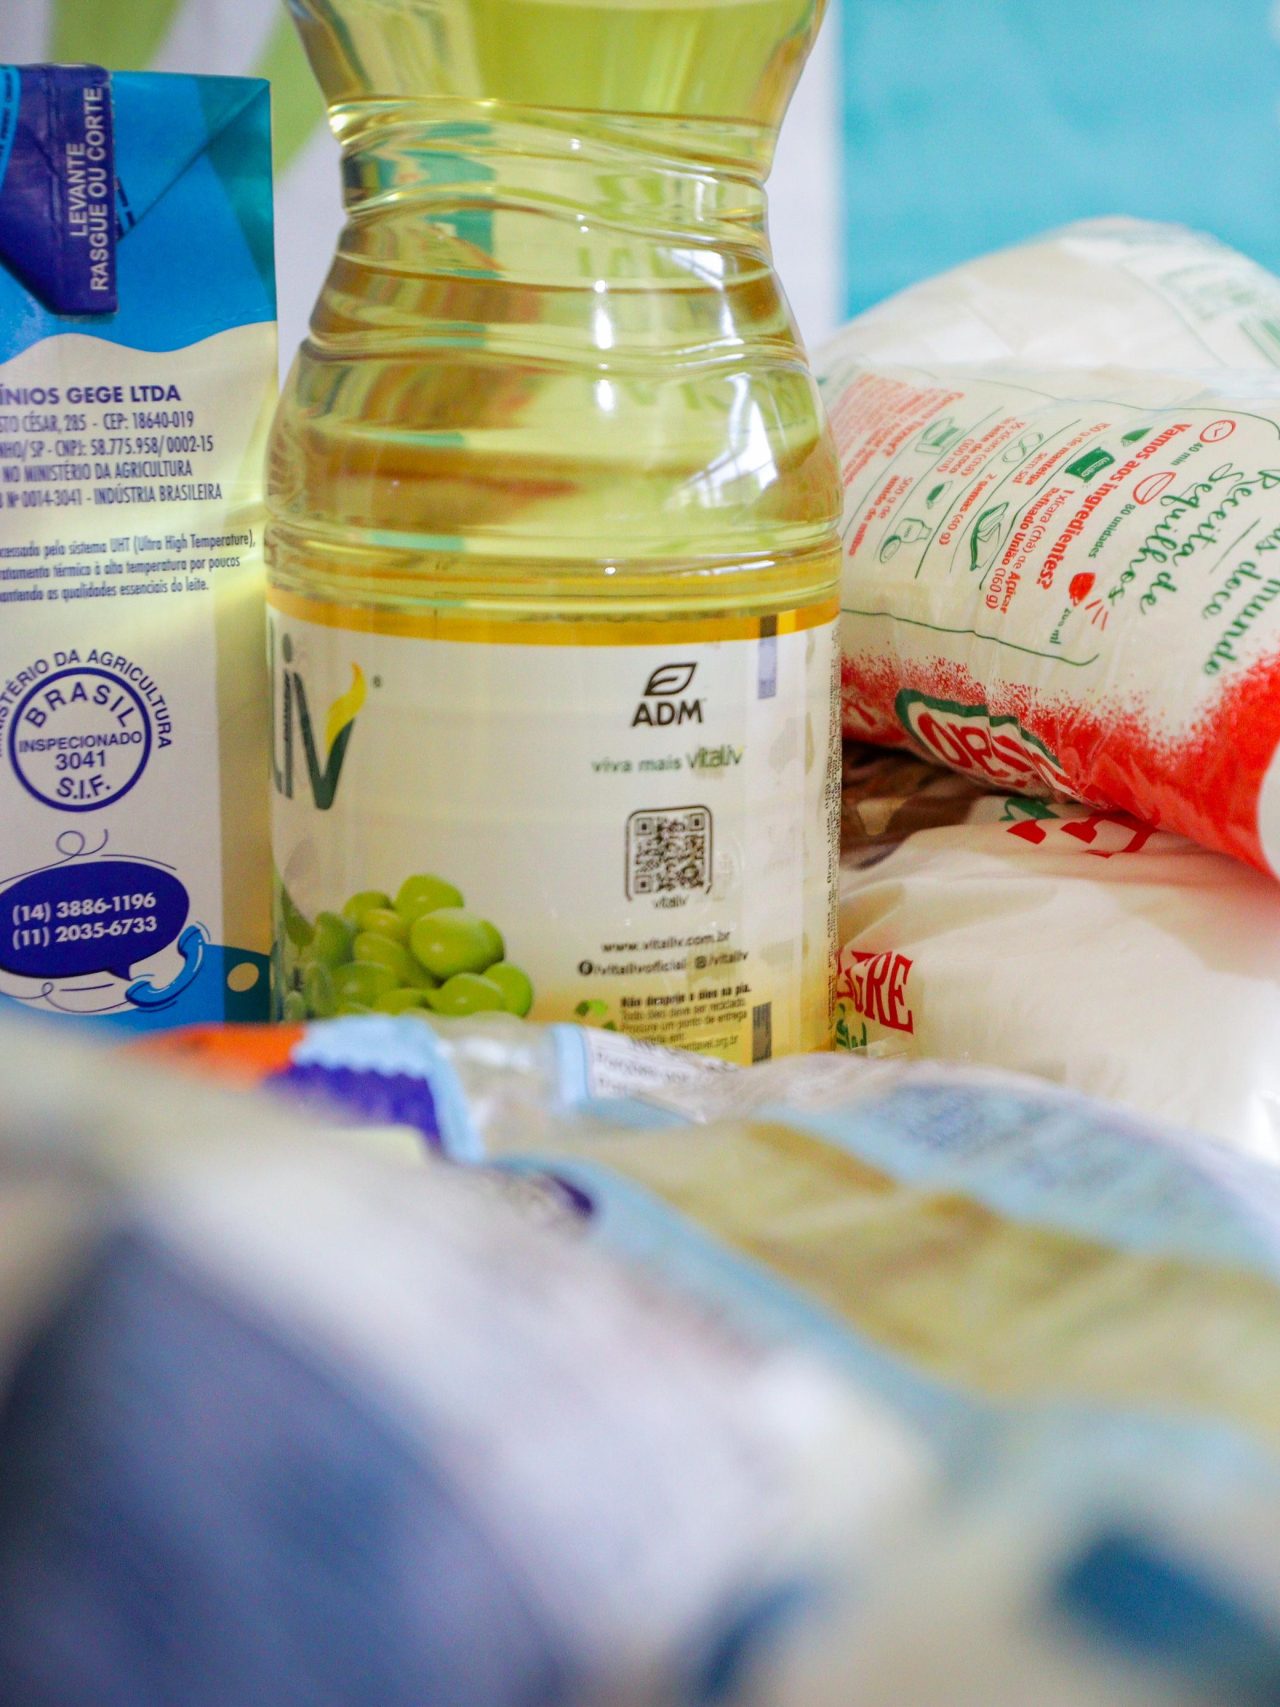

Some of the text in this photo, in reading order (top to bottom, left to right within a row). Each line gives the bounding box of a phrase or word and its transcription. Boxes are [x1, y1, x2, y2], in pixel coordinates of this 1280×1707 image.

[66, 142, 88, 236] LEVANTE
[83, 87, 109, 291] RASGUE OU CORTE
[66, 386, 123, 404] GEGE
[130, 384, 182, 402] LTDA
[23, 410, 62, 434] CÉSAR,
[103, 412, 128, 430] CEP:
[132, 410, 194, 429] 18640-019
[30, 440, 44, 458] SP
[1170, 453, 1190, 466] min
[24, 459, 91, 482] MINISTÉRIO
[95, 462, 111, 480] DA
[115, 459, 193, 479] AGRICULTURA
[1012, 471, 1026, 484] sal
[1025, 447, 1069, 485] manteiga
[94, 482, 156, 504] INDÚSTRIA
[159, 482, 223, 501] BRASILEIRA
[960, 480, 988, 513] gemas
[1036, 423, 1193, 590] Vamos aos ingredientes?
[1040, 495, 1069, 523] xícara
[68, 540, 107, 555] sistema
[109, 537, 130, 553] UHT
[165, 533, 187, 552] High
[1022, 525, 1046, 553] (chá)
[1088, 504, 1136, 559] 80 unidades
[1107, 463, 1245, 606] Sequilhos
[985, 488, 1060, 610] Refinado União (160 g)
[1013, 556, 1027, 569] de
[126, 558, 187, 576] temperatura
[190, 558, 206, 573] por
[209, 556, 240, 572] poucos
[62, 580, 116, 603] qualidades
[120, 579, 168, 596] essenciais
[171, 576, 182, 592] do
[185, 576, 209, 592] leite.
[1000, 571, 1021, 614] Açúcar
[1140, 571, 1177, 615] de
[1203, 561, 1262, 619] doce
[1050, 629, 1061, 644] ml
[25, 681, 134, 728] BRASIL
[54, 649, 80, 667] DA
[87, 649, 172, 749] AGRICULTURA
[631, 700, 702, 727] ADM
[19, 731, 142, 752] INSPECIONADO
[55, 750, 105, 771] 3041
[592, 757, 632, 772] viva
[638, 754, 682, 771] mais
[56, 774, 110, 800] S.I.F.
[12, 892, 157, 925] (14) 3886-1196
[12, 917, 157, 949] (11) 2035-6733
